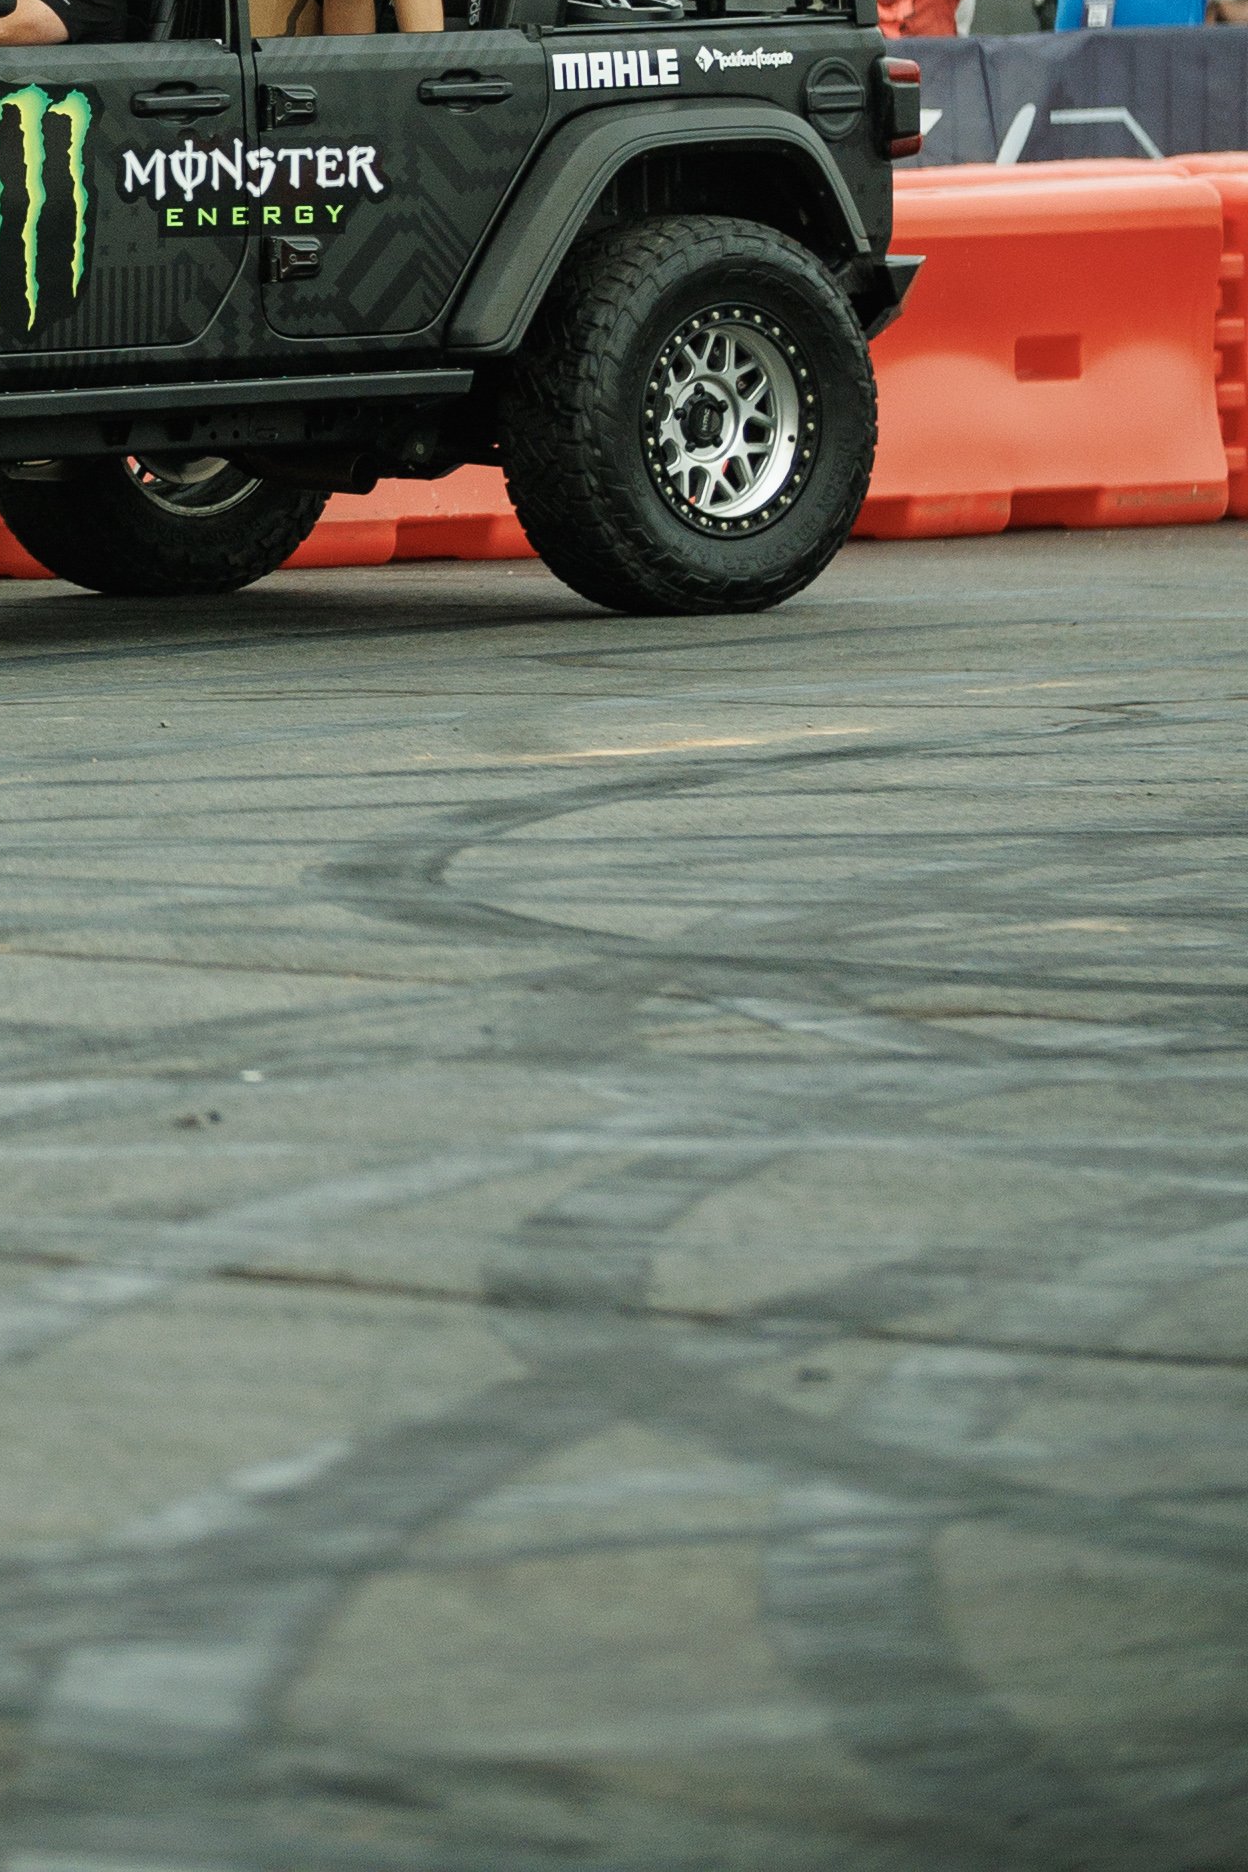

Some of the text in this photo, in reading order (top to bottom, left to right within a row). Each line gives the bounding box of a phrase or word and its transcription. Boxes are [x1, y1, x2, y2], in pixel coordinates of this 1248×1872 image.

[552, 48, 679, 90] MAHLE
[122, 138, 384, 201] MONSTER
[166, 205, 344, 227] ENERGY
